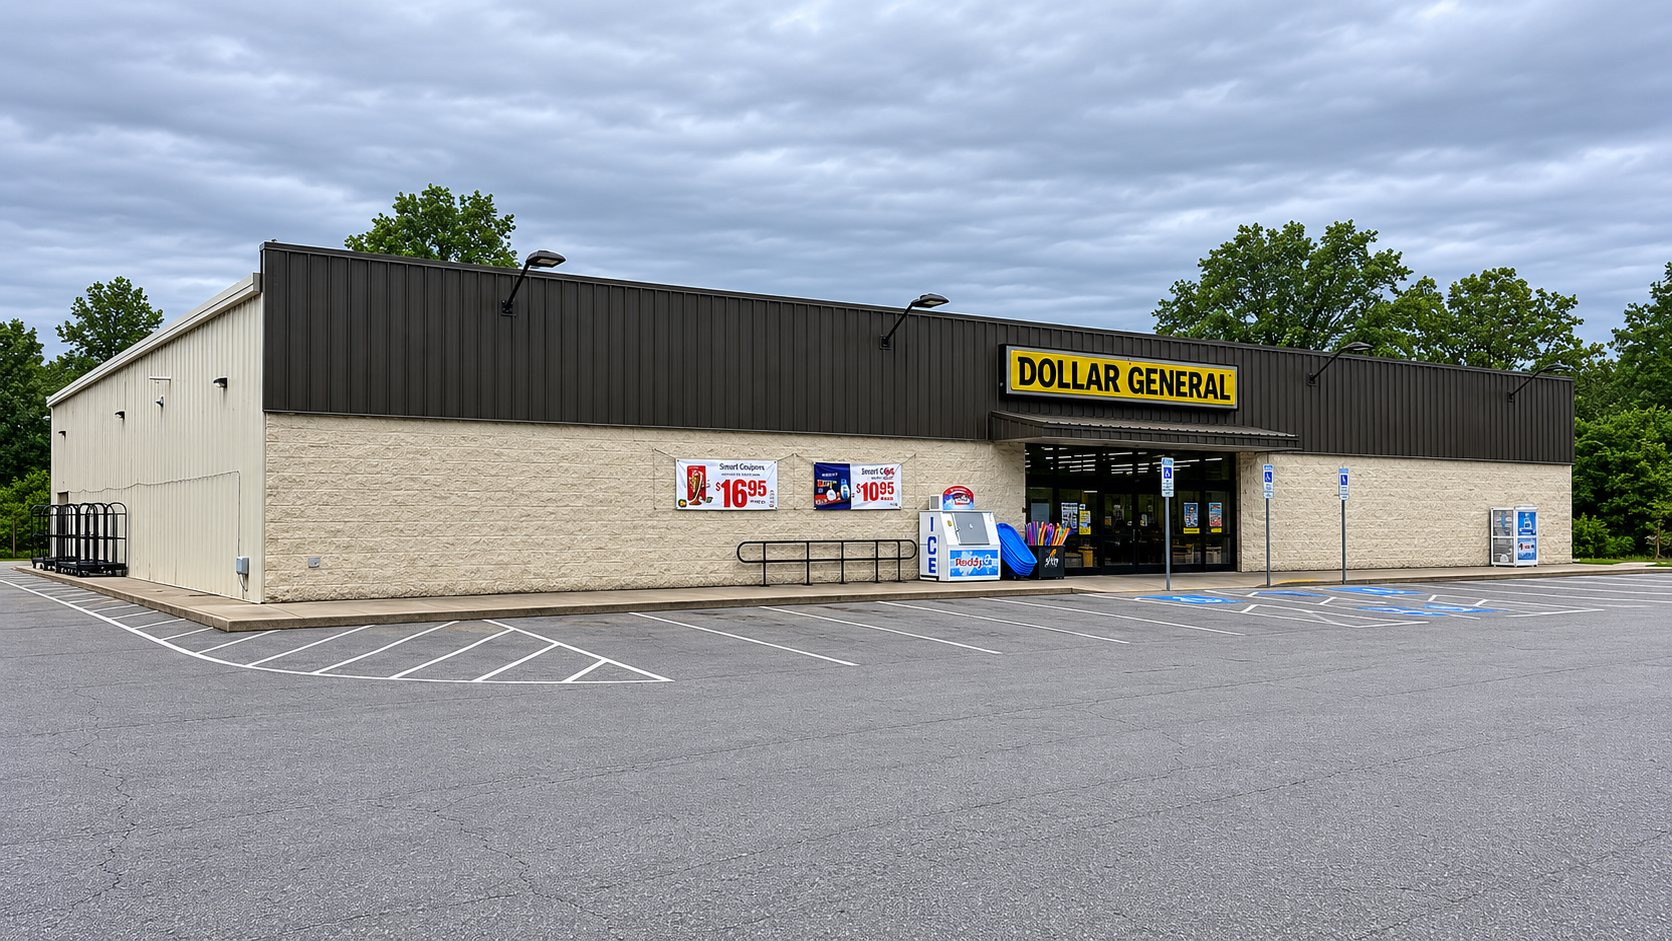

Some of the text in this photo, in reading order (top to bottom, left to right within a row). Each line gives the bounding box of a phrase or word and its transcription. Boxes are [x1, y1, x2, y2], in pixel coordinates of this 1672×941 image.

[1017, 356, 1231, 401] DOLLAR GENERAL
[927, 516, 937, 573] ICE
